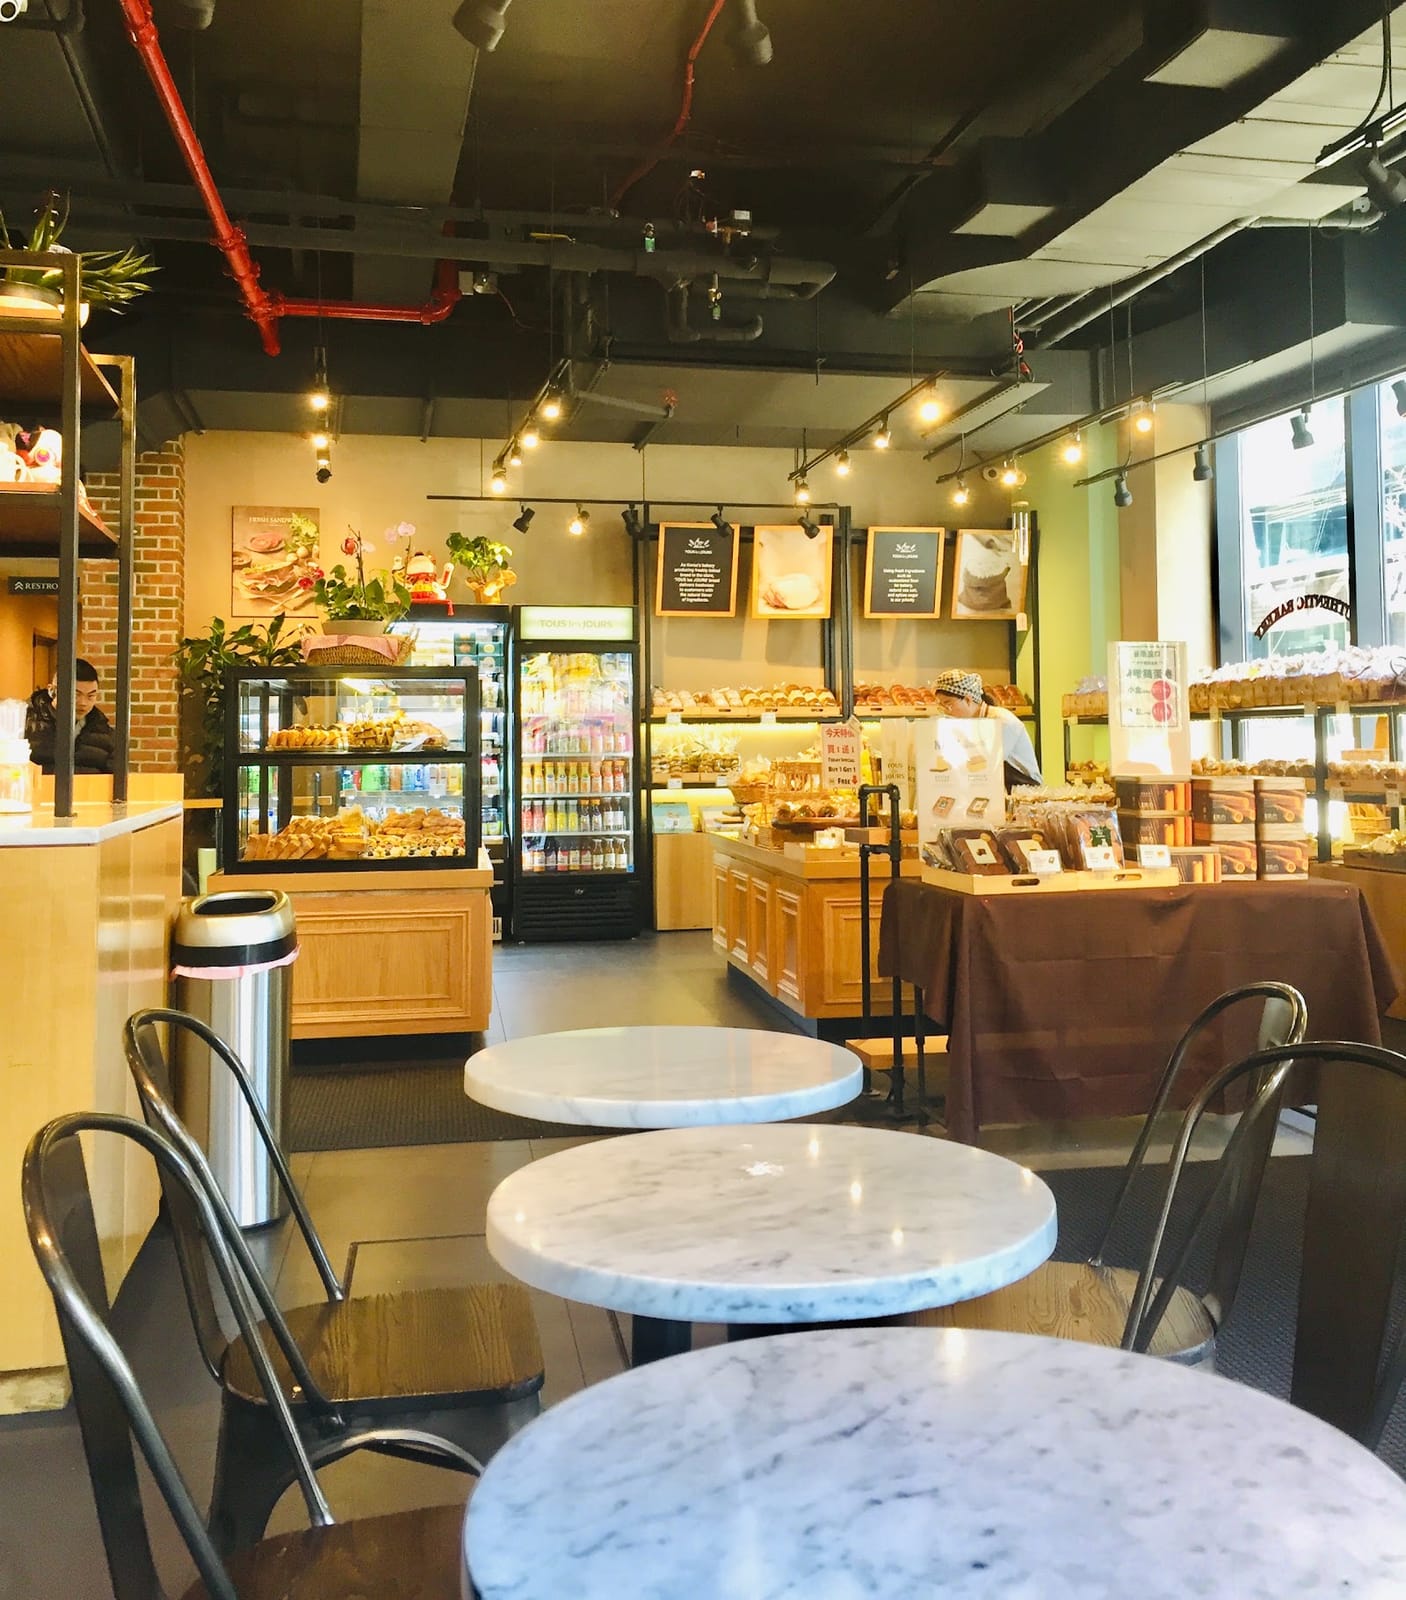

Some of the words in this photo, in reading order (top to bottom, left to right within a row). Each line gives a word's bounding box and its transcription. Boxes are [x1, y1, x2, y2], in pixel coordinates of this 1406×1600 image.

[25, 582, 59, 590] RESTRO
[540, 619, 567, 628] TOUS
[582, 619, 613, 630] JOURS
